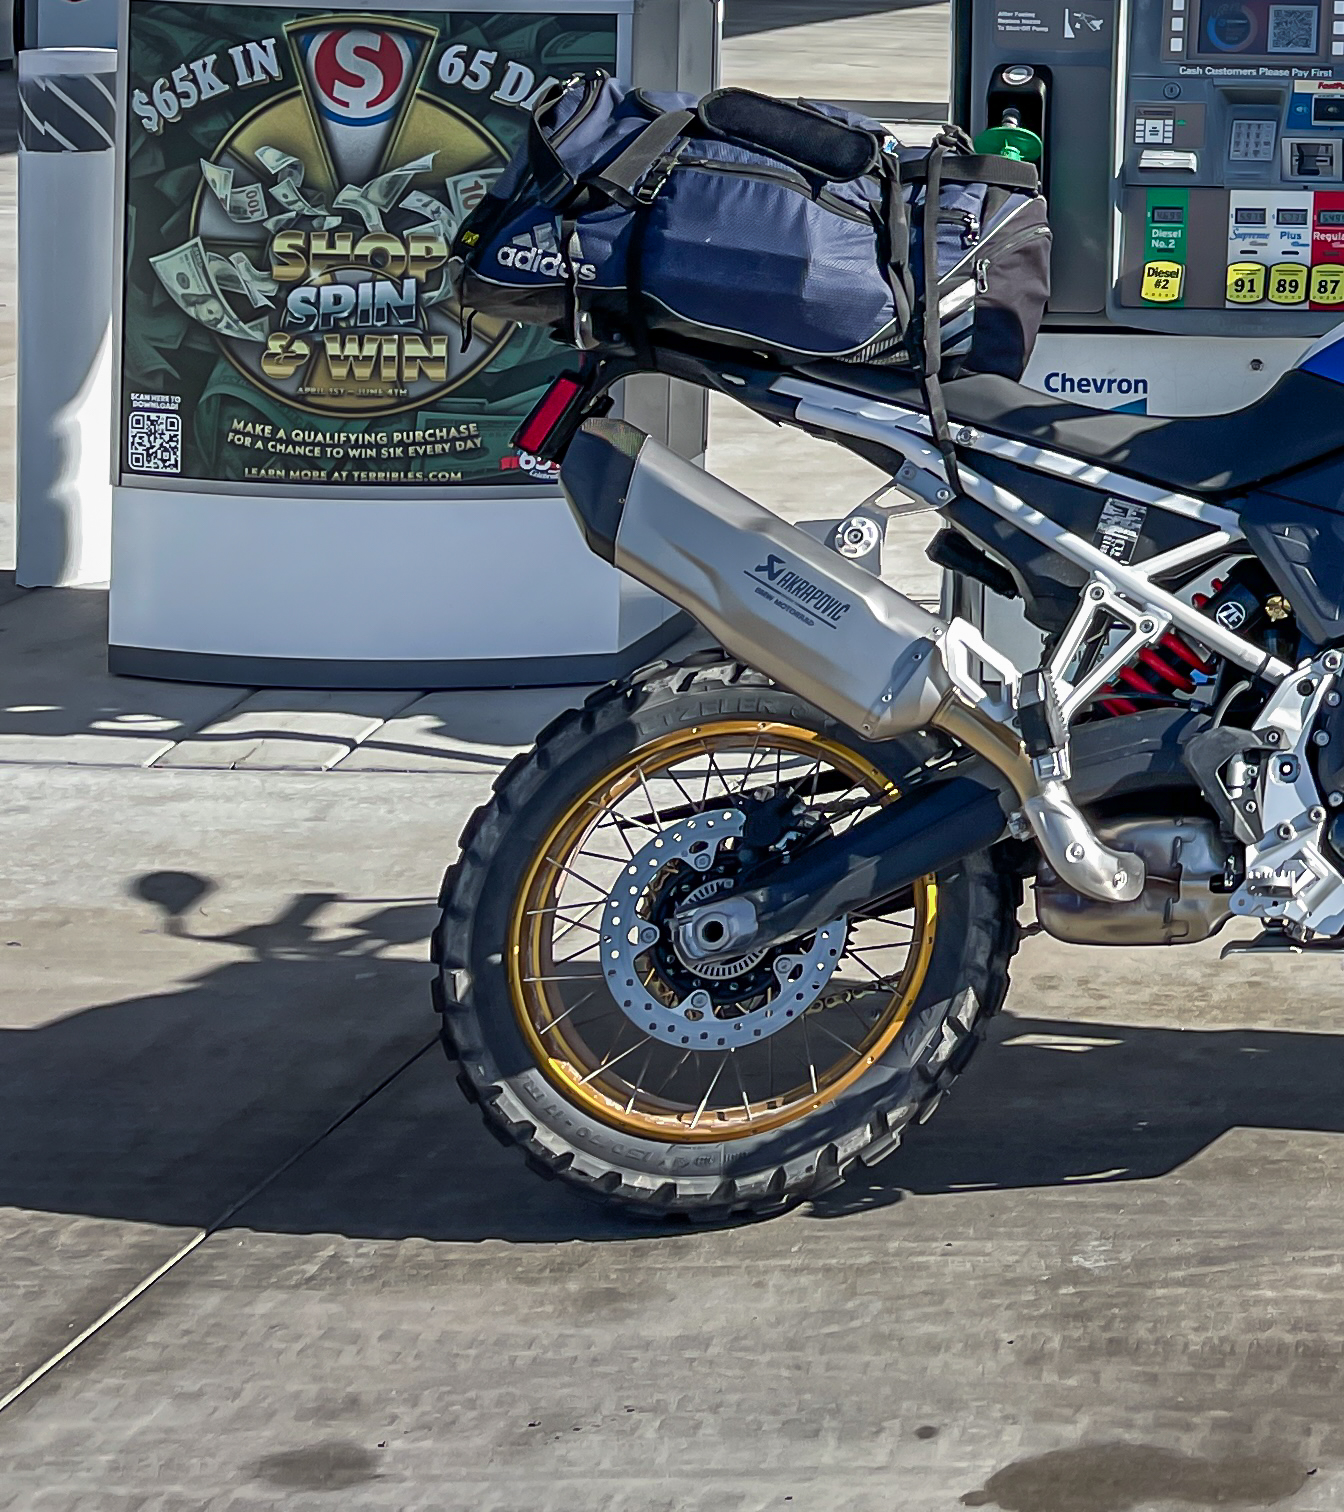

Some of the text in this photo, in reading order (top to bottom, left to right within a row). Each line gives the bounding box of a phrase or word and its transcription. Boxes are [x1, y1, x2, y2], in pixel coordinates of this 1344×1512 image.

[438, 44, 498, 91] 65
[1179, 66, 1333, 78] Cash Customers Please Pay First
[132, 38, 282, 133] $65K IN
[1152, 229, 1181, 238] Diesel
[1229, 228, 1271, 241] Supreme
[1280, 230, 1302, 240] Plus
[1151, 239, 1176, 249] No.2
[272, 230, 449, 282] SHOP
[1146, 267, 1180, 279] Diesel
[1153, 279, 1170, 290] #2
[1233, 278, 1256, 293] 91
[1275, 279, 1299, 293] 89
[1317, 280, 1341, 294] 87
[286, 278, 417, 331] SPIN
[261, 332, 449, 382] & WIN
[1043, 371, 1148, 394] Chevron
[131, 393, 181, 403] SCAN HERE TO
[298, 387, 326, 396] APRIL
[231, 418, 479, 445] MAKE A QUALIFYING PURCHASE
[227, 432, 251, 448] FOR
[255, 439, 264, 450] A
[267, 441, 321, 458] CHANCE
[325, 447, 344, 459] TO
[348, 446, 377, 459] WIN
[408, 442, 450, 458] EVERY
[455, 437, 482, 452] DAY
[244, 467, 463, 482] LEARN MORE AT TERRIBLES.COM
[754, 586, 775, 602] BMW
[1219, 605, 1246, 627] ZF
